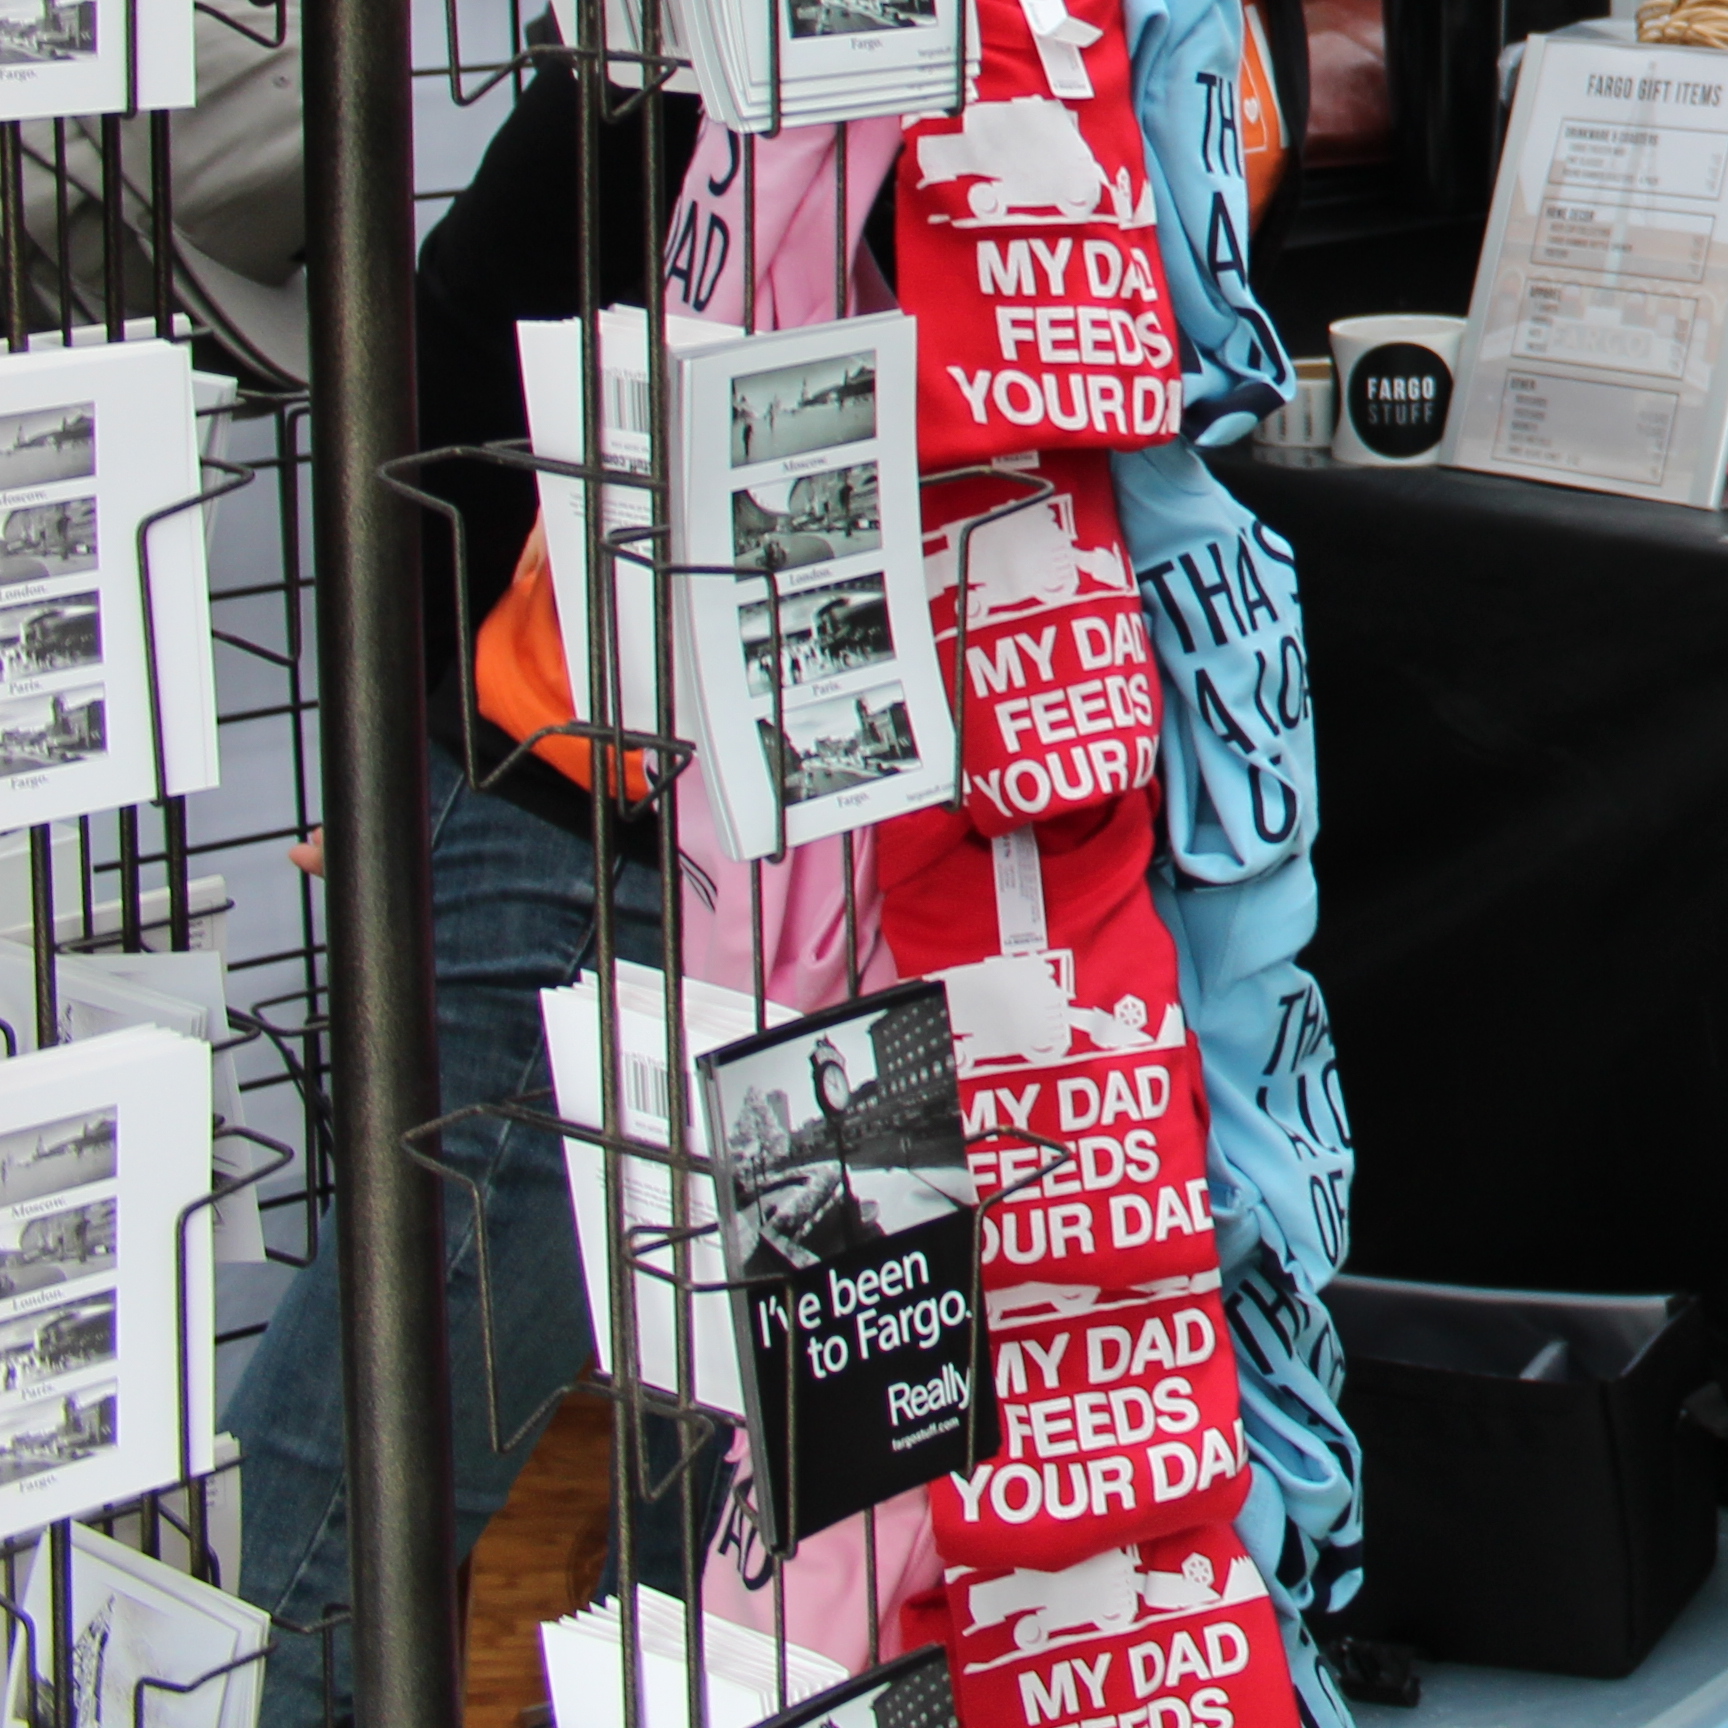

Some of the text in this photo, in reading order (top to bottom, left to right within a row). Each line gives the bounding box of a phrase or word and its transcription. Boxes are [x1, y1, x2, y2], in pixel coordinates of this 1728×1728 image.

[1587, 73, 1723, 107] FARGO GIFT ITEMS
[977, 238, 1073, 297] MY
[996, 305, 1173, 369] FEEDS
[947, 366, 1128, 435] YOUR
[1366, 376, 1436, 401] FARGO
[1367, 402, 1435, 426] STUFF
[966, 626, 1057, 698] MY
[994, 673, 1152, 753] FEEDS
[971, 737, 1128, 818] YOUR
[1057, 1065, 1170, 1133] DAD
[966, 1129, 1161, 1205] FEEDS
[1108, 1177, 1216, 1250] DAD
[828, 1249, 930, 1317] been
[807, 1287, 973, 1380] to Fargo.
[1086, 1307, 1216, 1385] DAD
[888, 1362, 972, 1426] Really
[1004, 1377, 1200, 1460] FEEDS
[891, 1416, 960, 1451] fargostuff.com
[949, 1455, 1136, 1524] YOUR
[1017, 1652, 1112, 1727] MY
[1128, 1621, 1250, 1700] DAD
